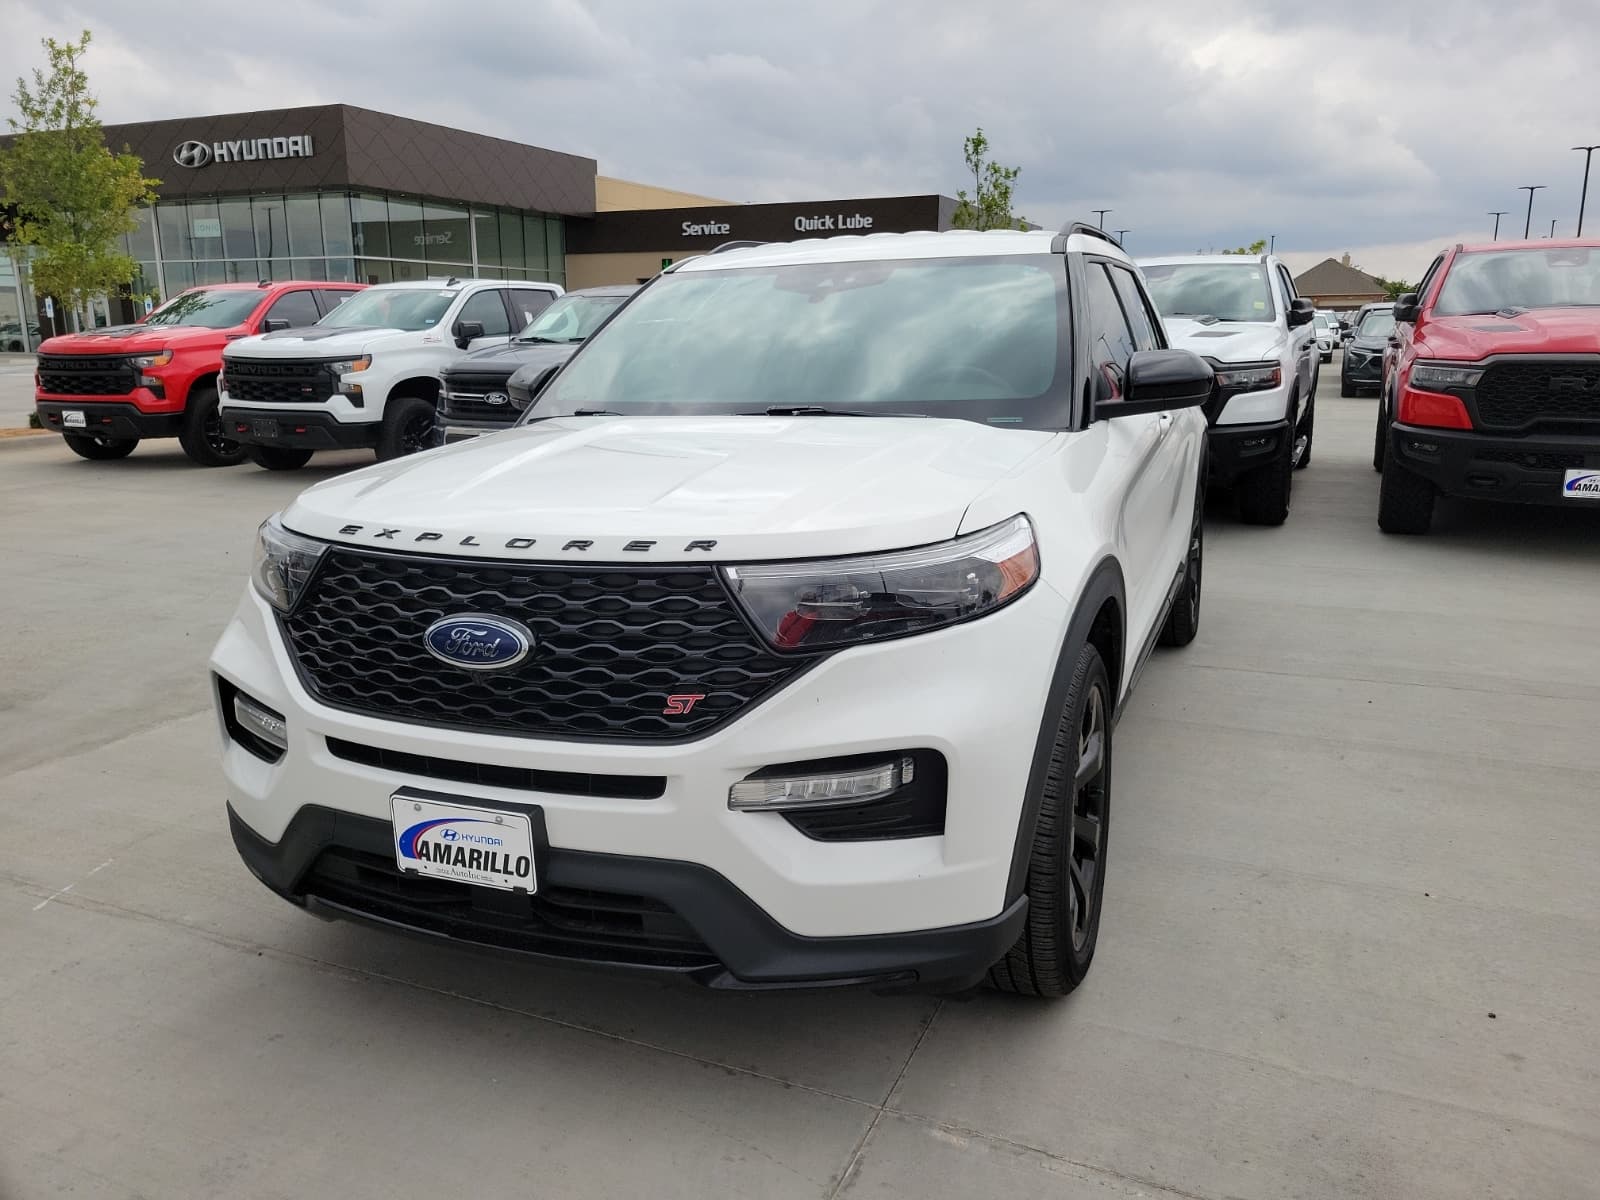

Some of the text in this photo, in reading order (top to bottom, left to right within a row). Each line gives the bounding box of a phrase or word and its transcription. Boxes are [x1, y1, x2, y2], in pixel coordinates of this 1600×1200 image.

[213, 134, 314, 163] HYUNDAI
[681, 220, 730, 236] Service
[794, 213, 873, 232] Quick Lube
[338, 524, 718, 552] EXPLORER
[445, 627, 502, 658] Ford
[662, 693, 706, 715] ST
[461, 833, 503, 847] HYUNDAI
[419, 839, 531, 878] AMARILLO
